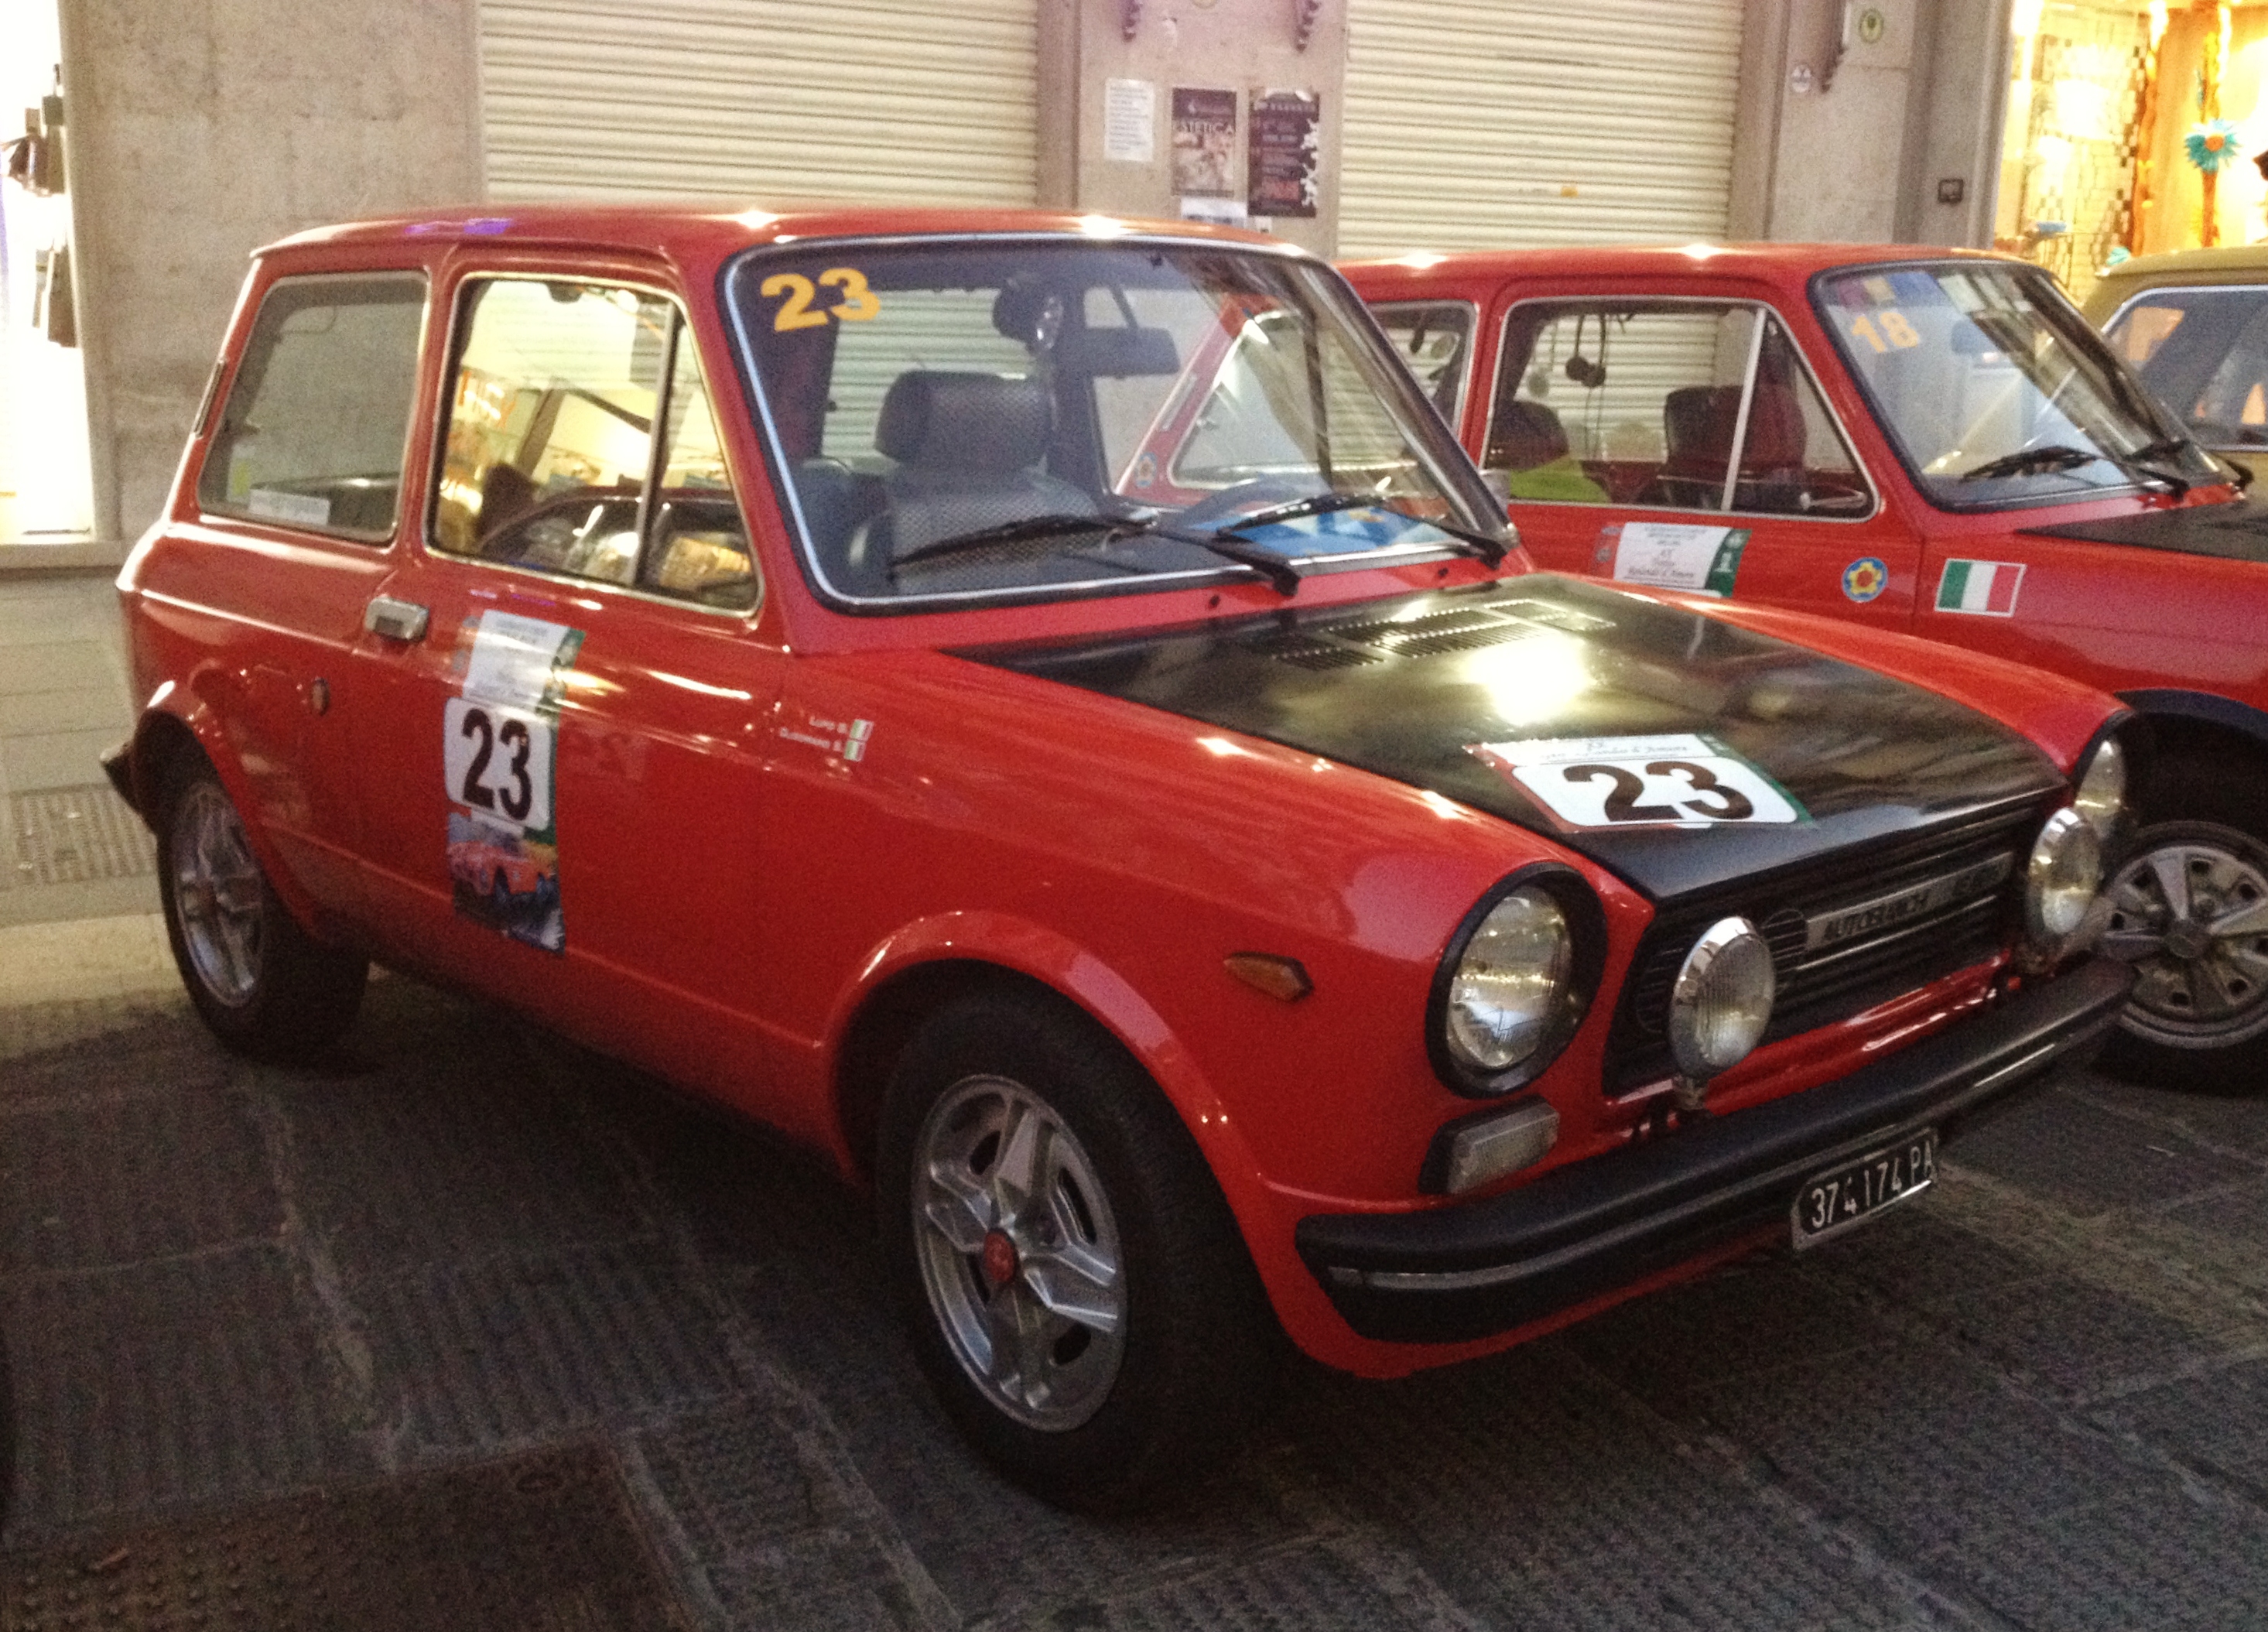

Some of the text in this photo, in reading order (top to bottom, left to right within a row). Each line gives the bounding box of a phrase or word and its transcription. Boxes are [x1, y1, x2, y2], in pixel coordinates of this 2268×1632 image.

[761, 267, 881, 332] 23
[1852, 312, 1919, 354] 18
[463, 708, 532, 822] 23
[1563, 761, 1754, 823] 23
